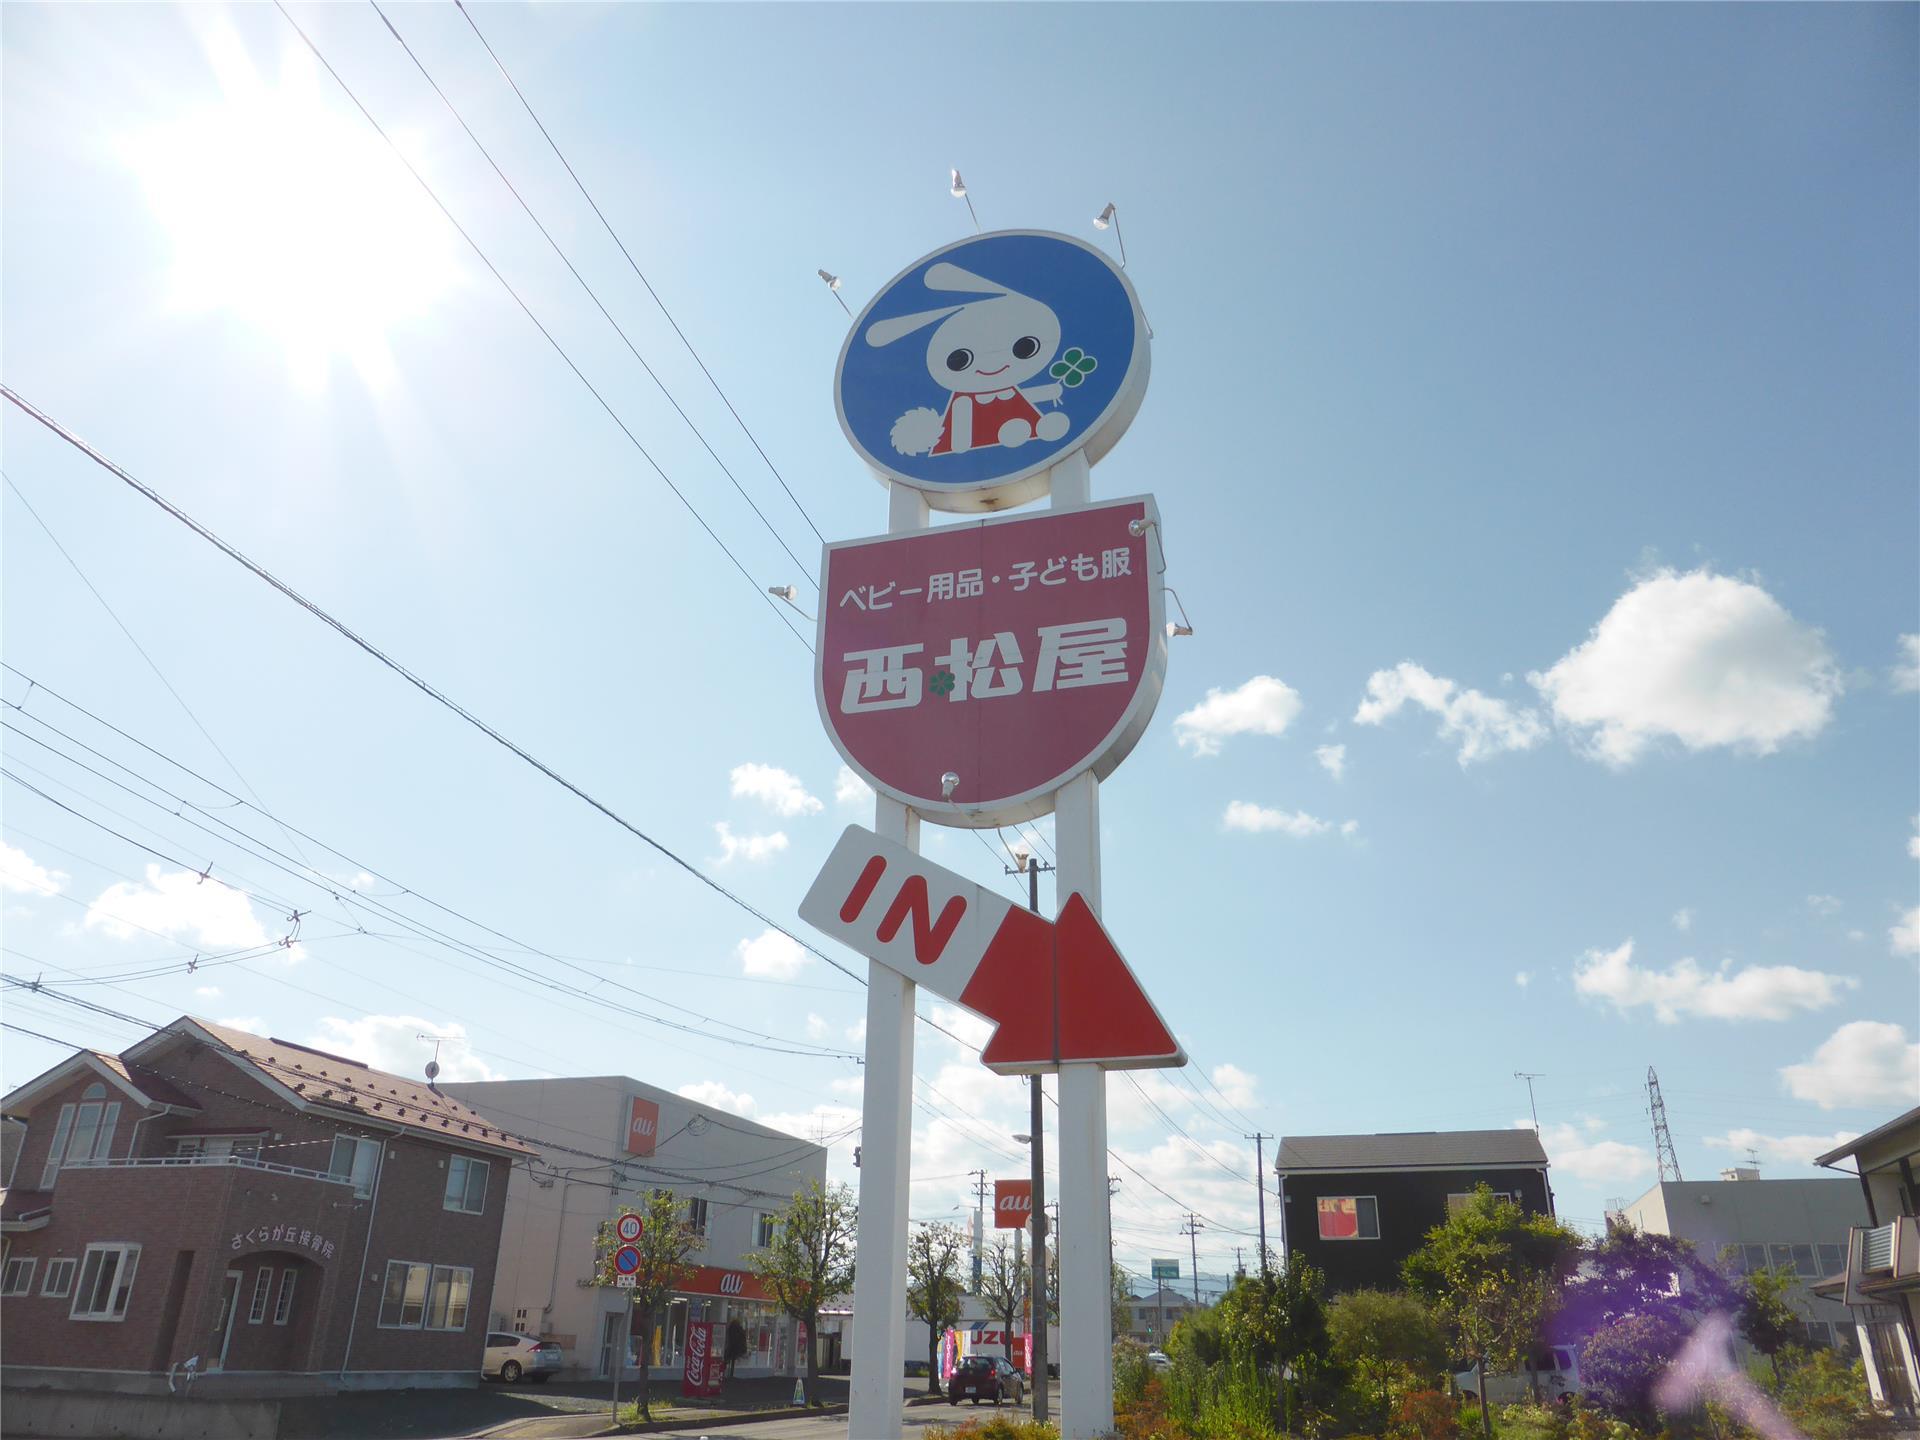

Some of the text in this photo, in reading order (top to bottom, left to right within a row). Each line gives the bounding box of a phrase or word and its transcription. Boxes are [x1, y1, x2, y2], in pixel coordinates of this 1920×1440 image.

[839, 547, 1132, 611] ベビー用品・子ども服
[840, 617, 1129, 714] 西松屋
[839, 855, 968, 965] IN
[633, 1117, 655, 1136] au
[1000, 1195, 1032, 1210] au
[231, 1224, 335, 1259] さくらが丘接骨院
[623, 1222, 638, 1235] 40
[720, 1273, 743, 1294] au
